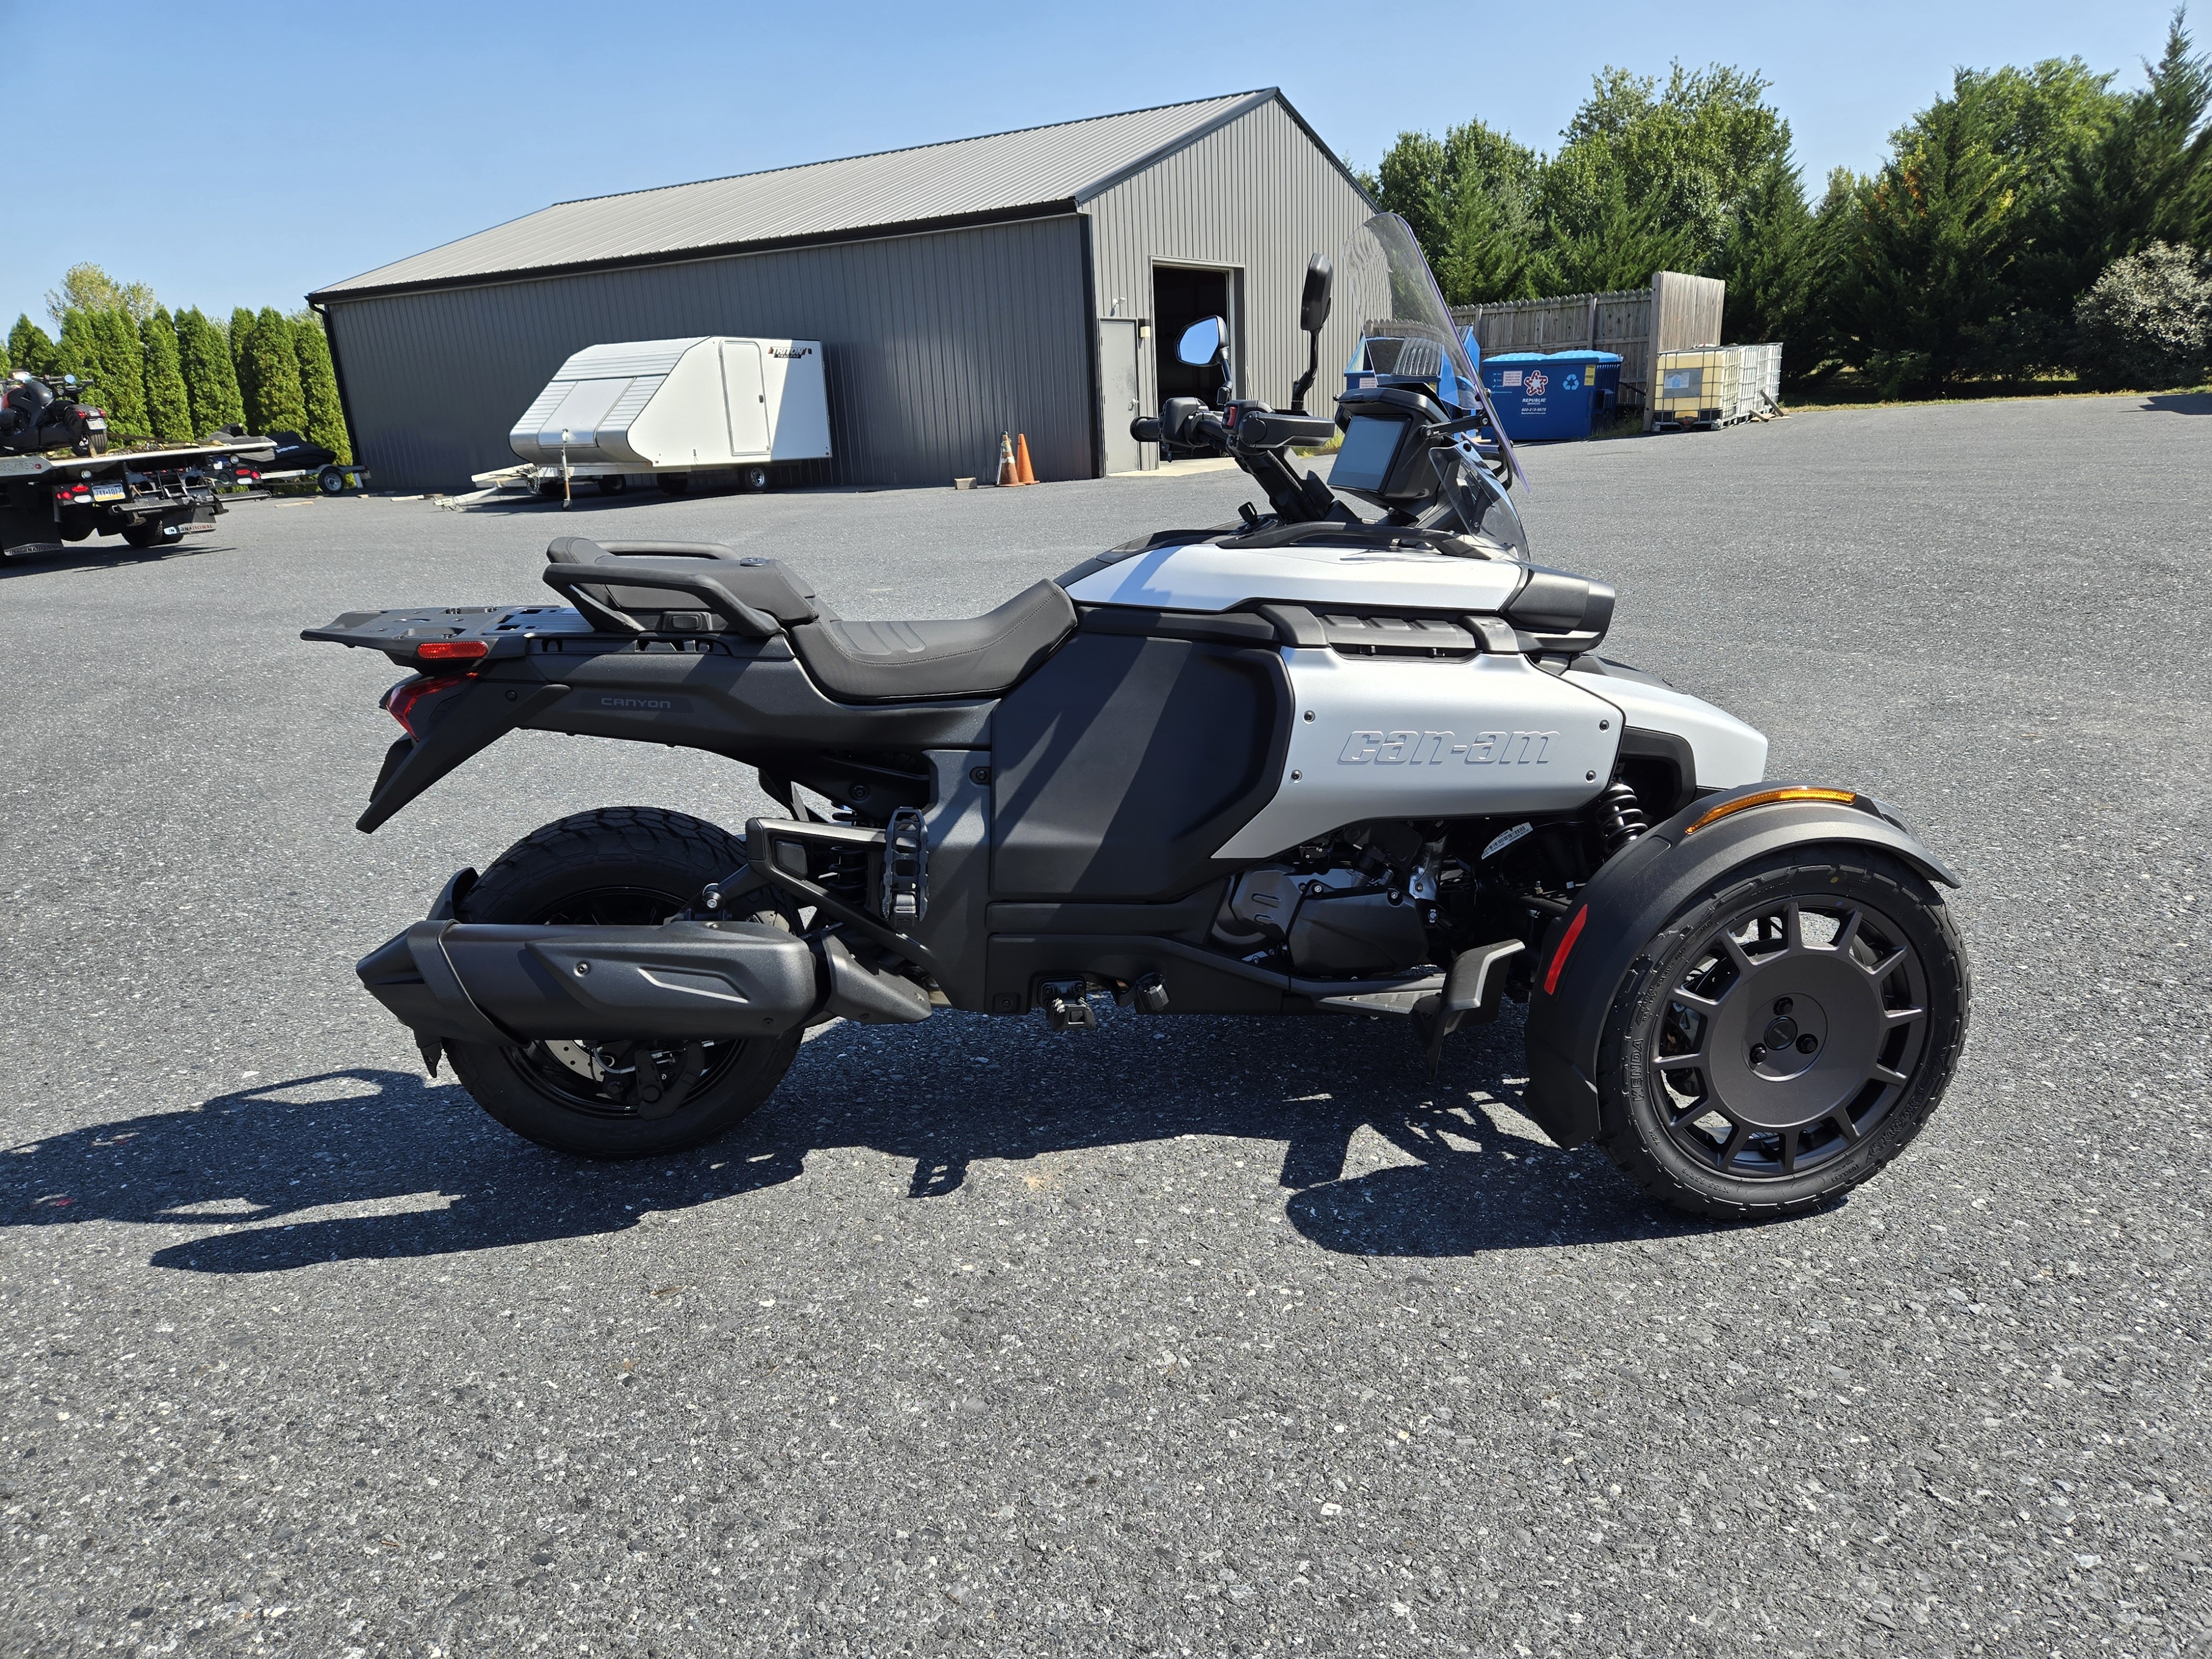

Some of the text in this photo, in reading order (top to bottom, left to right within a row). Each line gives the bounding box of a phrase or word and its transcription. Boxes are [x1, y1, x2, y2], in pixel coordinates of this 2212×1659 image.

[772, 347, 804, 355] TRITON
[601, 697, 671, 708] CANYON
[1337, 730, 1561, 765] can-am
[1631, 1038, 1645, 1102] KENDA
